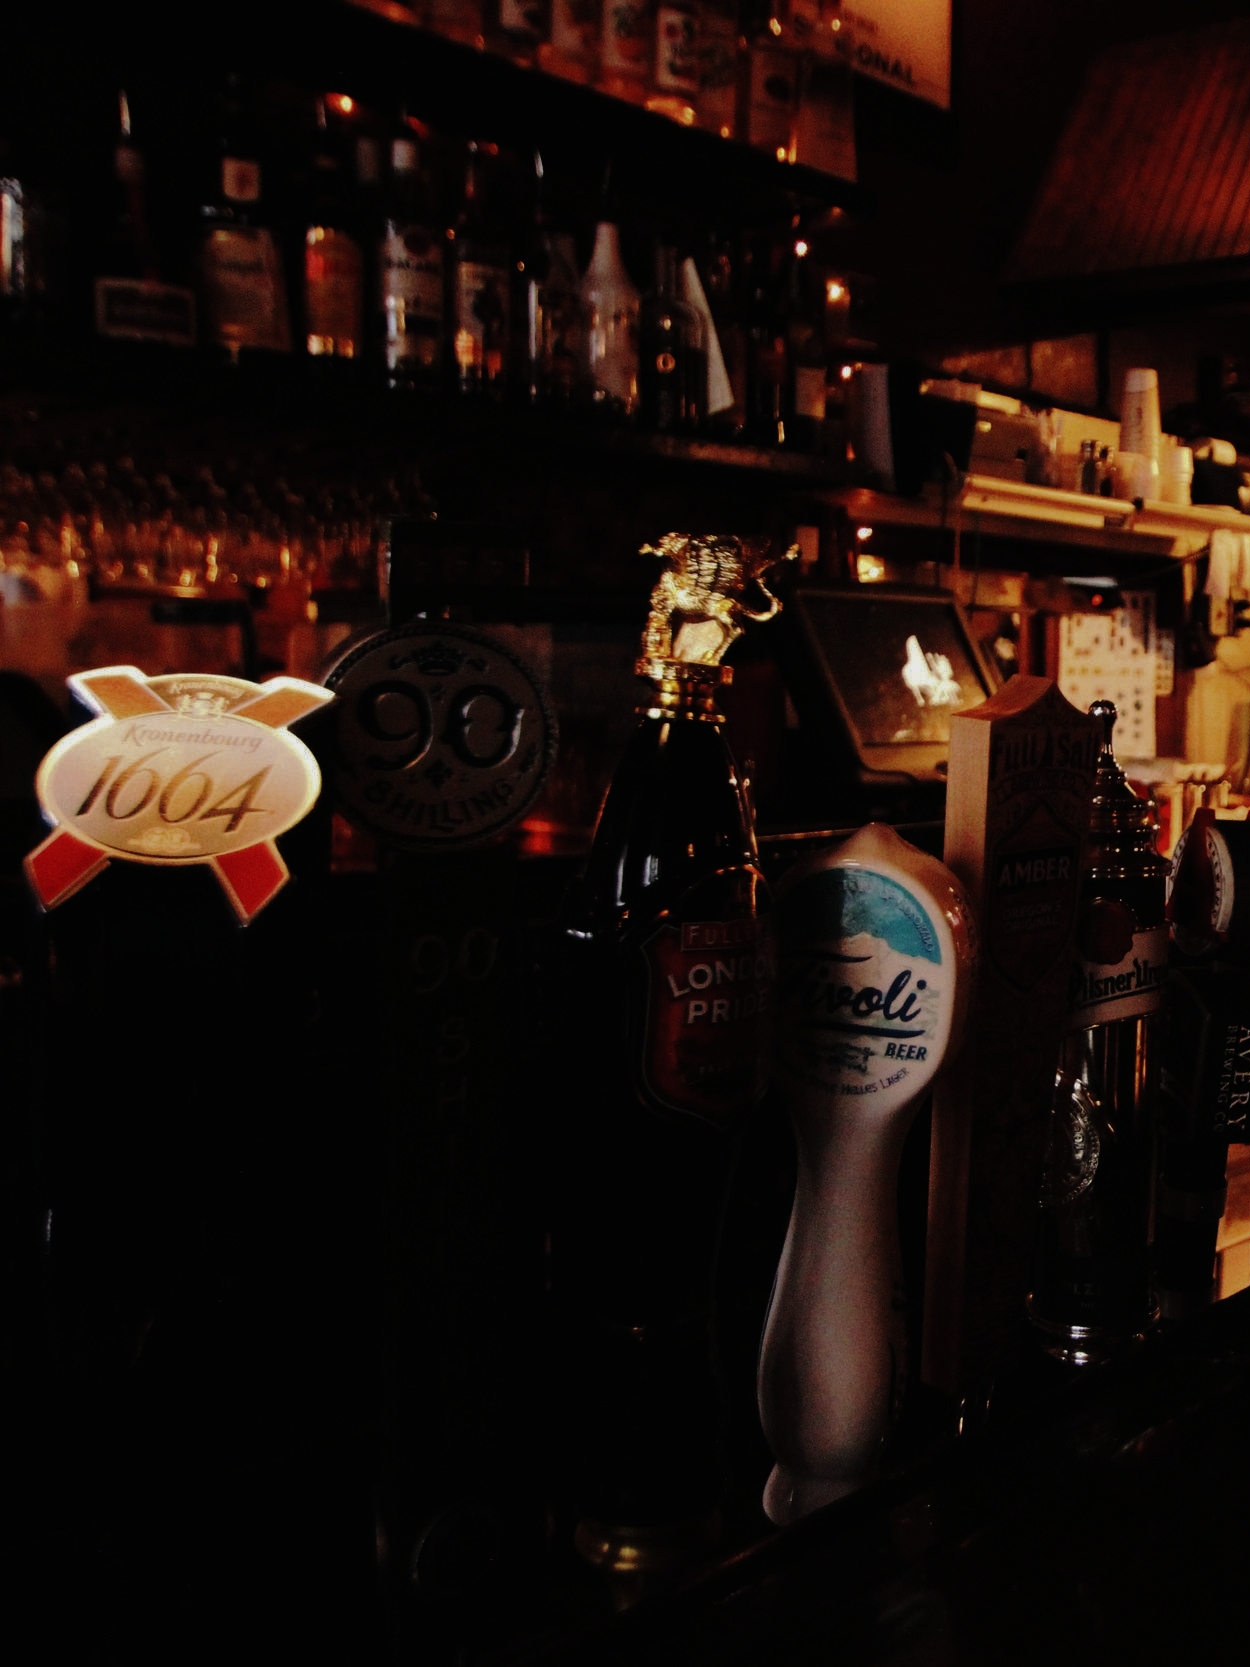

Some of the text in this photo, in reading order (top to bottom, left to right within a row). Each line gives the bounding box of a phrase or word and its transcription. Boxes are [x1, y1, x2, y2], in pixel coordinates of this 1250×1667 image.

[123, 723, 265, 754] Kronenbourg
[356, 679, 524, 770] 90
[989, 732, 1102, 780] Full Sail
[76, 747, 275, 834] 1664
[364, 780, 513, 834] SHILLING
[998, 855, 1072, 889] AMBER
[1003, 917, 1058, 936] ORIGINAL
[409, 926, 500, 996] 90
[667, 957, 779, 998] LONDON
[687, 986, 769, 1025] PRIDE
[1066, 959, 1136, 1016] Pilsner
[885, 1042, 927, 1061] BEER
[1216, 1024, 1239, 1105] BREWING
